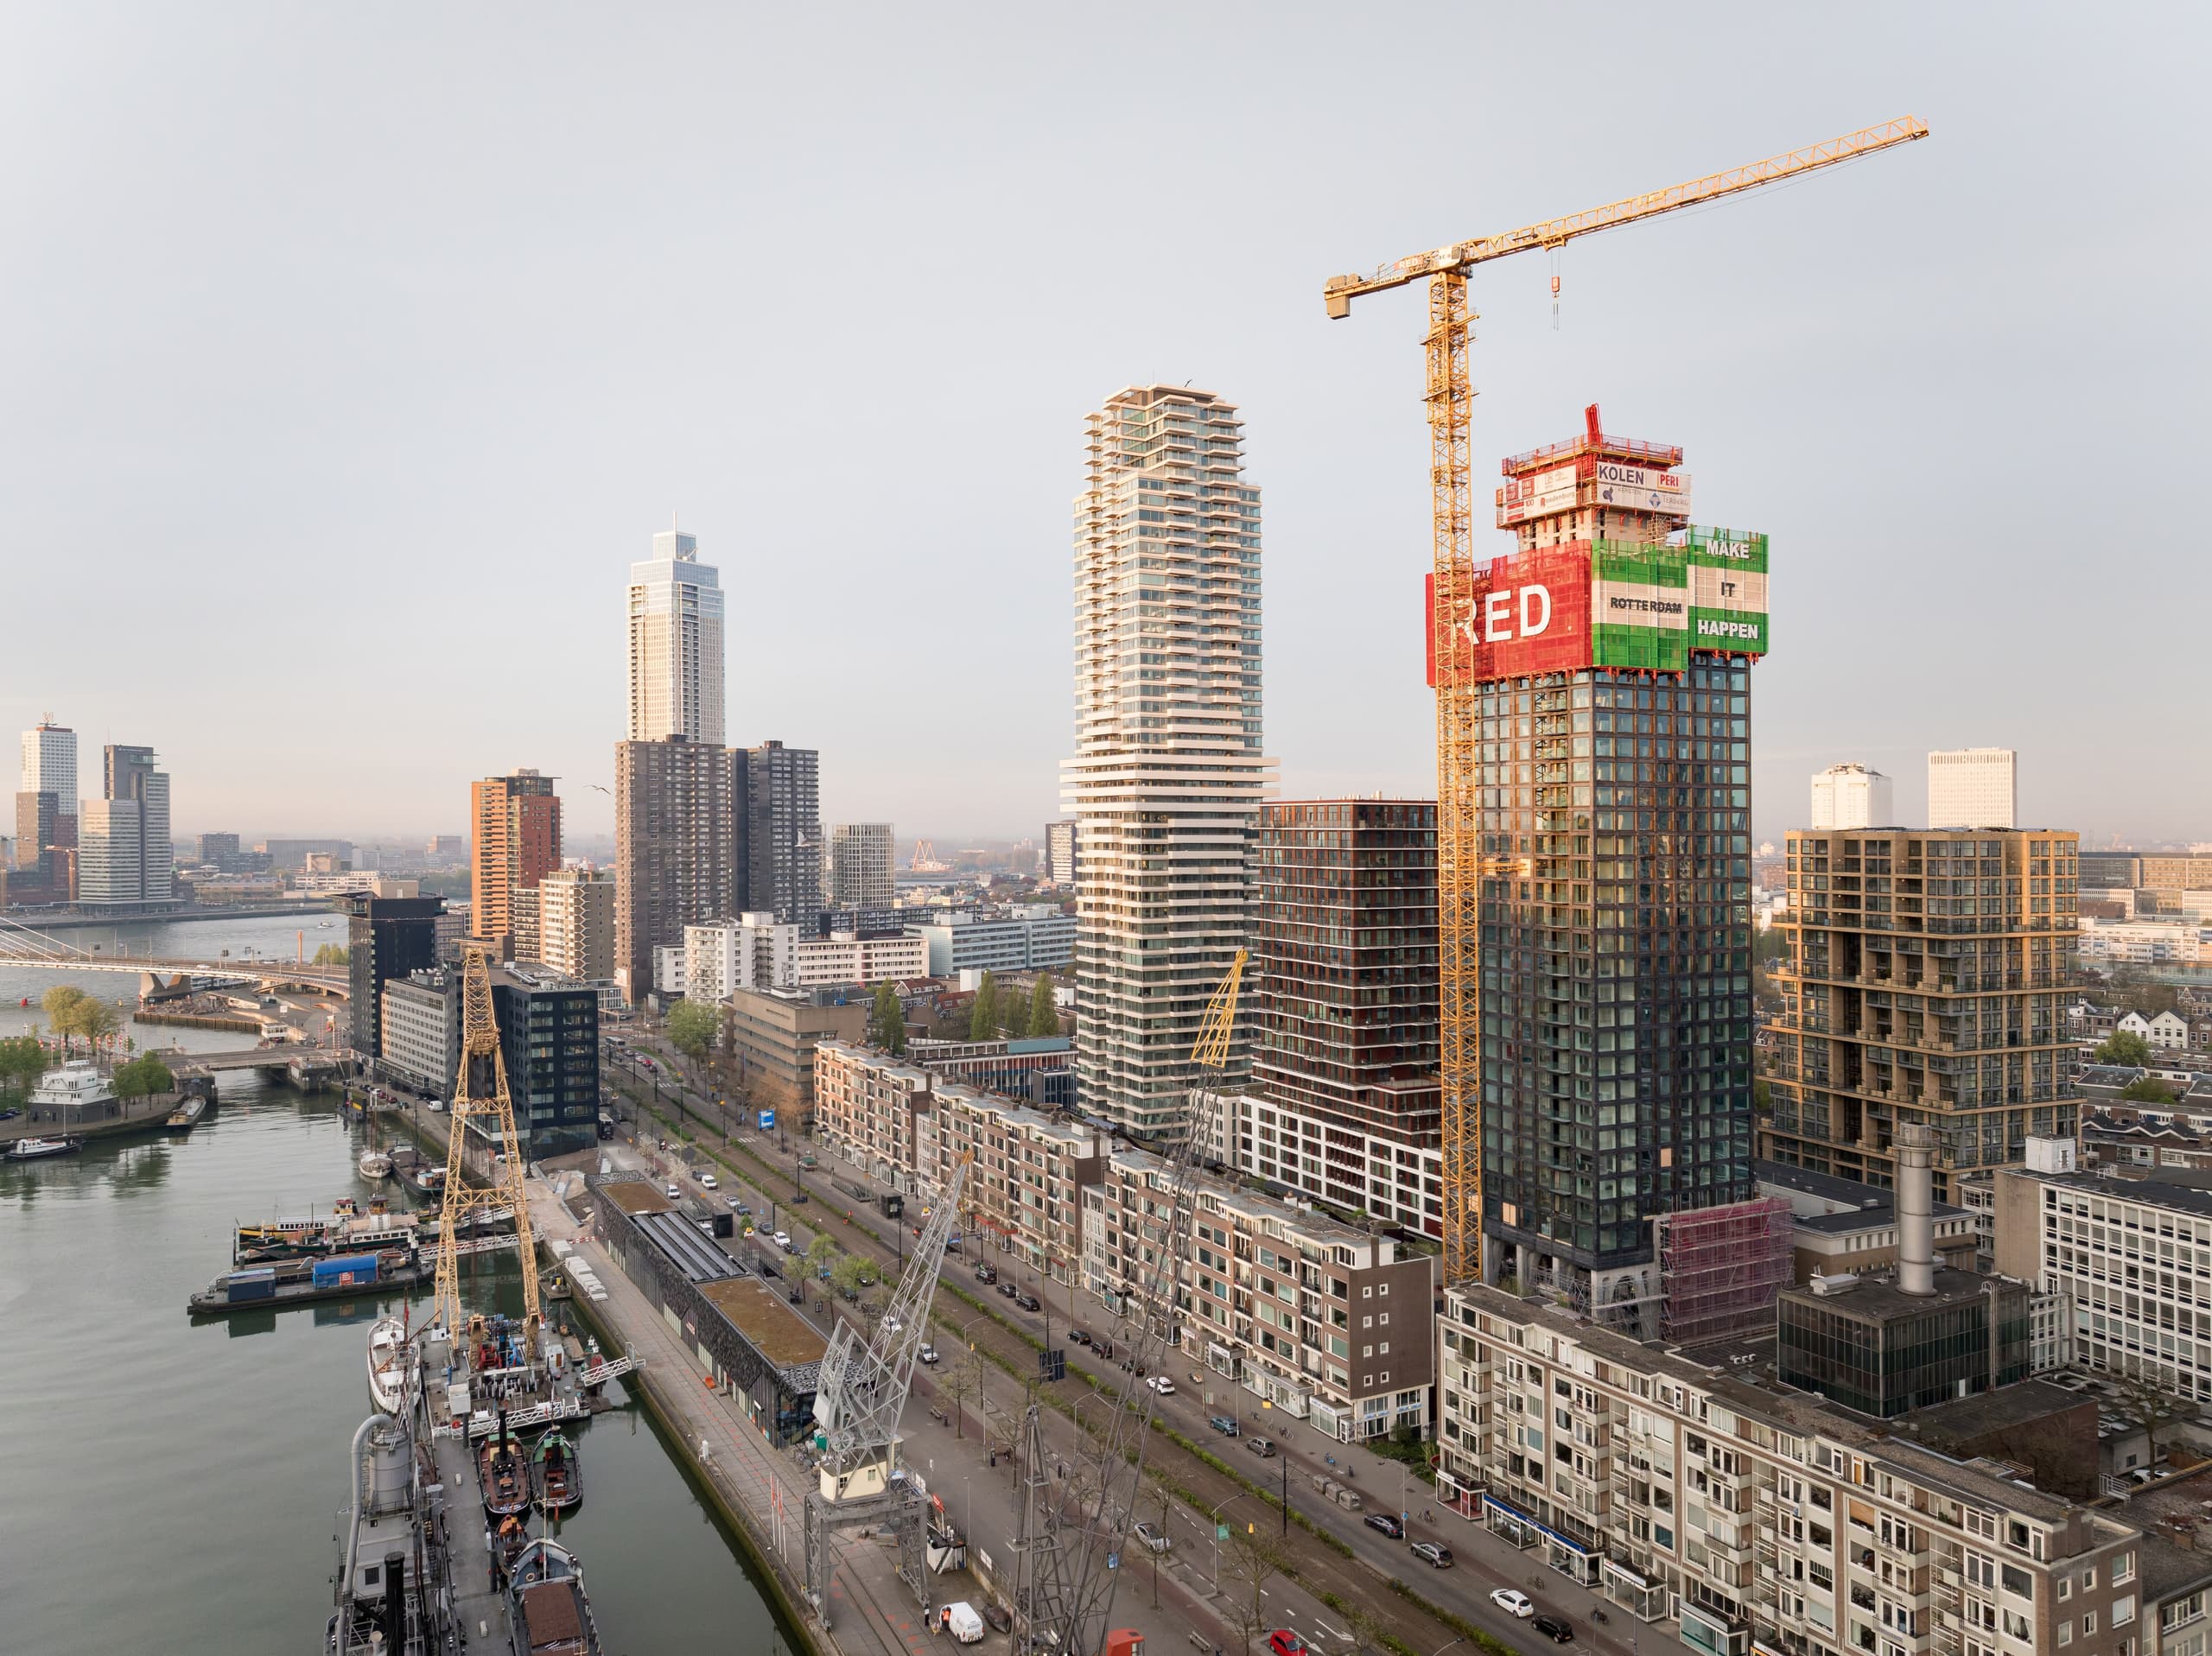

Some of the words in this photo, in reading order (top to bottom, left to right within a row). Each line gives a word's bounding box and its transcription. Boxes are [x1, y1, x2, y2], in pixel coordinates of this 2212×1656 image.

[1599, 465, 1644, 485] KOLEN
[1660, 473, 1679, 487] PERI
[1706, 539, 1750, 559] MAKE
[1720, 581, 1736, 597] IT
[1610, 596, 1682, 614] ROTTERDAM
[1697, 619, 1758, 640] HAPPEN
